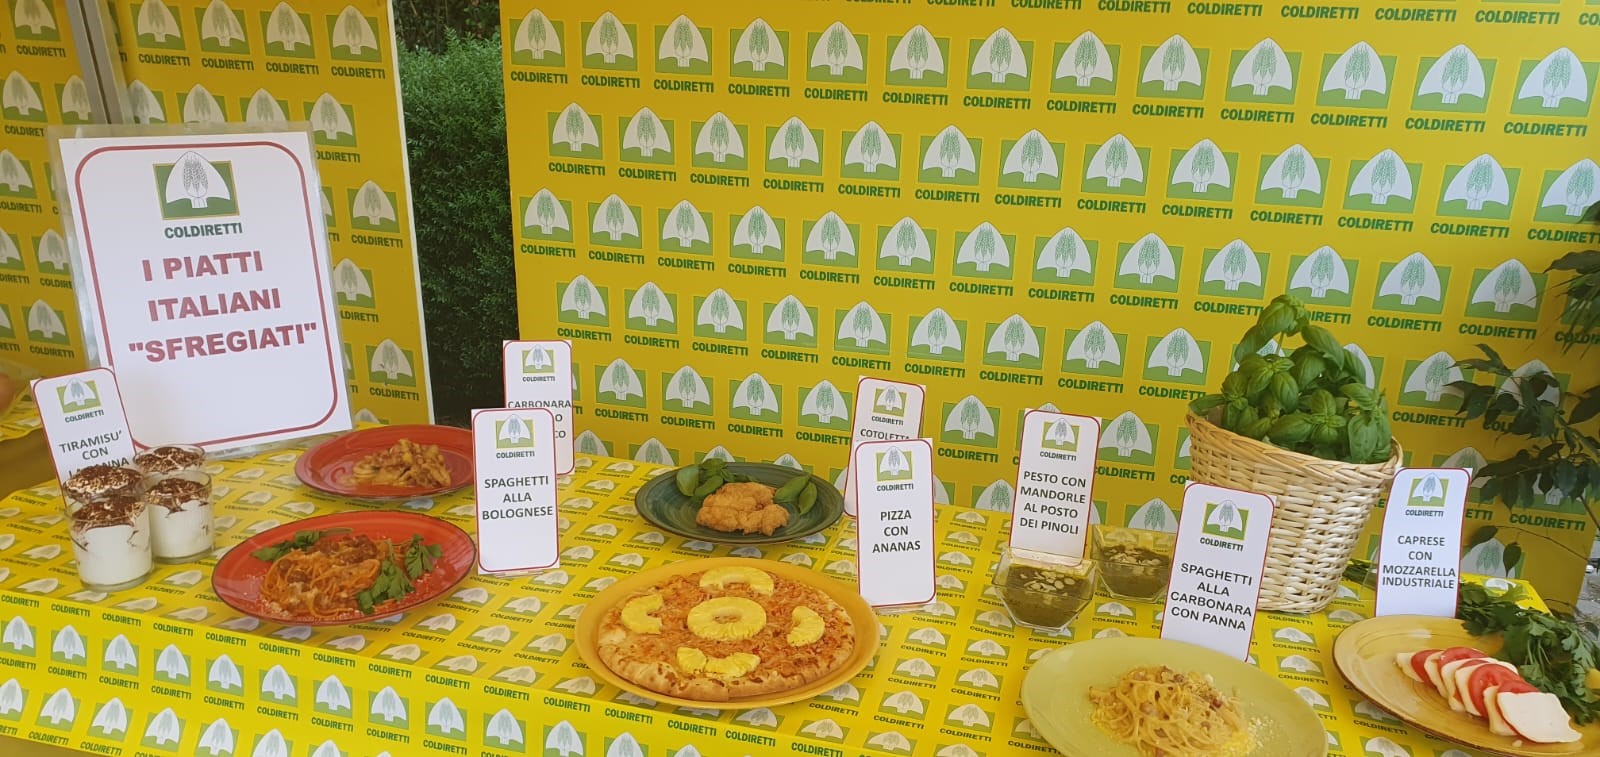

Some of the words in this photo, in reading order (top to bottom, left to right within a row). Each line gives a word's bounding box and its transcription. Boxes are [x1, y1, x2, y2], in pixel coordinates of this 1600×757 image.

[1012, 0, 1082, 10] COLDIRETTI
[1098, 0, 1171, 14] COLDIRETTI
[1188, 3, 1263, 17] COLDIRETTI
[1282, 6, 1360, 20] COLDIRETTI
[1376, 8, 1457, 22] COLDIRETTI
[1476, 11, 1560, 25] COLDIRETTI
[17, 45, 66, 58] COLDIRETTI
[139, 54, 190, 67] COLDIRETTI
[202, 58, 254, 71] COLDIRETTI
[266, 62, 319, 75] COLDIRETTI
[331, 67, 386, 79] COLDIRETTI
[511, 72, 568, 84] COLDIRETTI
[582, 76, 640, 89] COLDIRETTI
[654, 80, 714, 93] COLDIRETTI
[729, 84, 790, 97] COLDIRETTI
[805, 88, 868, 102] COLDIRETTI
[883, 92, 948, 106] COLDIRETTI
[964, 96, 1031, 110] COLDIRETTI
[1047, 100, 1117, 114] COLDIRETTI
[1133, 104, 1204, 118] COLDIRETTI
[1221, 109, 1295, 123] COLDIRETTI
[1311, 114, 1388, 129] COLDIRETTI
[1406, 118, 1486, 132] COLDIRETTI
[1504, 122, 1587, 137] COLDIRETTI
[549, 163, 606, 176] COLDIRETTI
[619, 168, 677, 182] COLDIRETTI
[691, 174, 750, 187] COLDIRETTI
[764, 180, 824, 193] COLDIRETTI
[838, 184, 901, 198] COLDIRETTI
[915, 189, 980, 203] COLDIRETTI
[995, 195, 1062, 208] COLDIRETTI
[1078, 199, 1146, 214] COLDIRETTI
[1162, 205, 1233, 219] COLDIRETTI
[1251, 211, 1323, 226] COLDIRETTI
[165, 223, 243, 239] COLDIRETTI
[1338, 217, 1414, 232] COLDIRETTI
[1431, 223, 1510, 238] COLDIRETTI
[352, 234, 403, 248] COLDIRETTI
[521, 244, 576, 258] COLDIRETTI
[589, 251, 645, 265] COLDIRETTI
[142, 260, 153, 281] I
[163, 251, 263, 280] PIATTI
[658, 257, 715, 271] COLDIRETTI
[729, 264, 787, 278] COLDIRETTI
[800, 271, 860, 284] COLDIRETTI
[874, 276, 935, 290] COLDIRETTI
[950, 282, 1014, 297] COLDIRETTI
[1029, 288, 1095, 303] COLDIRETTI
[148, 288, 281, 322] ITALIANI
[1110, 295, 1179, 310] COLDIRETTI
[340, 310, 379, 322] LDIRETTI
[1368, 316, 1442, 332] COLDIRETTI
[558, 328, 612, 342] COLDIRETTI
[1459, 324, 1537, 340] COLDIRETTI
[129, 322, 317, 362] "SFREGIATI"
[625, 335, 680, 349] COLDIRETTI
[693, 342, 749, 356] COLDIRETTI
[30, 345, 74, 358] COLDIRETTI
[762, 349, 819, 364] COLDIRETTI
[832, 357, 891, 371] COLDIRETTI
[905, 364, 966, 378] COLDIRETTI
[980, 371, 1043, 386] COLDIRETTI
[1058, 378, 1124, 394] COLDIRETTI
[370, 387, 420, 401] COLDIRETTI
[65, 409, 104, 423] COLDIRETTI
[595, 409, 649, 422] COLDIRETTI
[871, 415, 904, 426] COLDIRETTI
[1391, 410, 1467, 428] COLDIRETTI
[661, 416, 715, 430] COLDIRETTI
[728, 424, 784, 438] COLDIRETTI
[82, 446, 108, 460] CON
[495, 451, 535, 459] COLDIRETTI
[938, 448, 999, 463] COLDIRETTI
[1039, 451, 1077, 461] COLDIRETTI
[484, 475, 549, 488] SPAGHETTI
[1023, 471, 1058, 484] PESTO
[1061, 476, 1086, 488] CON
[876, 483, 914, 492] COLDIRETTI
[503, 492, 532, 503] ALLA
[1020, 486, 1086, 504] MANDORLE
[482, 506, 553, 520] BOLOGNESE
[880, 509, 912, 521] PIZZA
[1023, 502, 1038, 513] AL
[1040, 504, 1078, 519] POSTO
[1405, 509, 1444, 517] COLDIRETTI
[1019, 517, 1038, 529] DEI
[1040, 520, 1079, 535] PINOLI
[1510, 514, 1586, 531] COLDIRETTI
[883, 526, 909, 537] CON
[872, 541, 921, 554] ANANAS
[1200, 537, 1244, 552] COLDIRETTI
[1397, 535, 1445, 547] CAPRESE
[1408, 551, 1432, 561] CON
[1180, 562, 1253, 586] SPAGHETTI
[1382, 564, 1456, 577] MOZZARELLA
[1197, 581, 1230, 597] ALLA
[1382, 577, 1455, 589] INDUSTRIALE
[1, 594, 39, 608] COLDIRETTI
[1170, 591, 1252, 617] CARBONARA
[51, 603, 90, 617] COLDIRETTI
[102, 613, 141, 627] COLDIRETTI
[1171, 606, 1200, 621] CON
[1202, 613, 1246, 631] PANNA
[153, 622, 193, 637] COLDIRETTI
[205, 632, 247, 647] COLDIRETTI
[258, 642, 300, 657] COLDIRETTI
[312, 652, 356, 668] COLDIRETTI
[47, 666, 87, 680] COLDIRETTI
[368, 663, 412, 679] COLDIRETTI
[99, 676, 139, 690] COLDIRETTI
[425, 674, 470, 690] COLDIRETTI
[887, 677, 936, 689] COLDIRETTI
[1277, 673, 1329, 686] COLDIRETTI
[151, 685, 192, 700] COLDIRETTI
[483, 685, 529, 701] COLDIRETTI
[951, 688, 1001, 702] COLDIRETTI
[203, 695, 245, 710] COLDIRETTI
[543, 696, 591, 713] COLDIRETTI
[809, 702, 859, 717] COLDIRETTI
[256, 706, 299, 721] COLDIRETTI
[604, 708, 653, 724] COLDIRETTI
[311, 717, 354, 733] COLDIRETTI
[667, 719, 717, 737] COLDIRETTI
[874, 715, 925, 730] COLDIRETTI
[1353, 719, 1408, 736] COLDIRETTI
[28, 730, 69, 746] COLDIRETTI
[366, 728, 410, 744] COLDIRETTI
[725, 730, 776, 747] COLDIRETTI
[939, 728, 992, 742] COLDIRETTI
[423, 739, 467, 756] COLDIRETTI
[791, 742, 843, 757] COLDIRETTI
